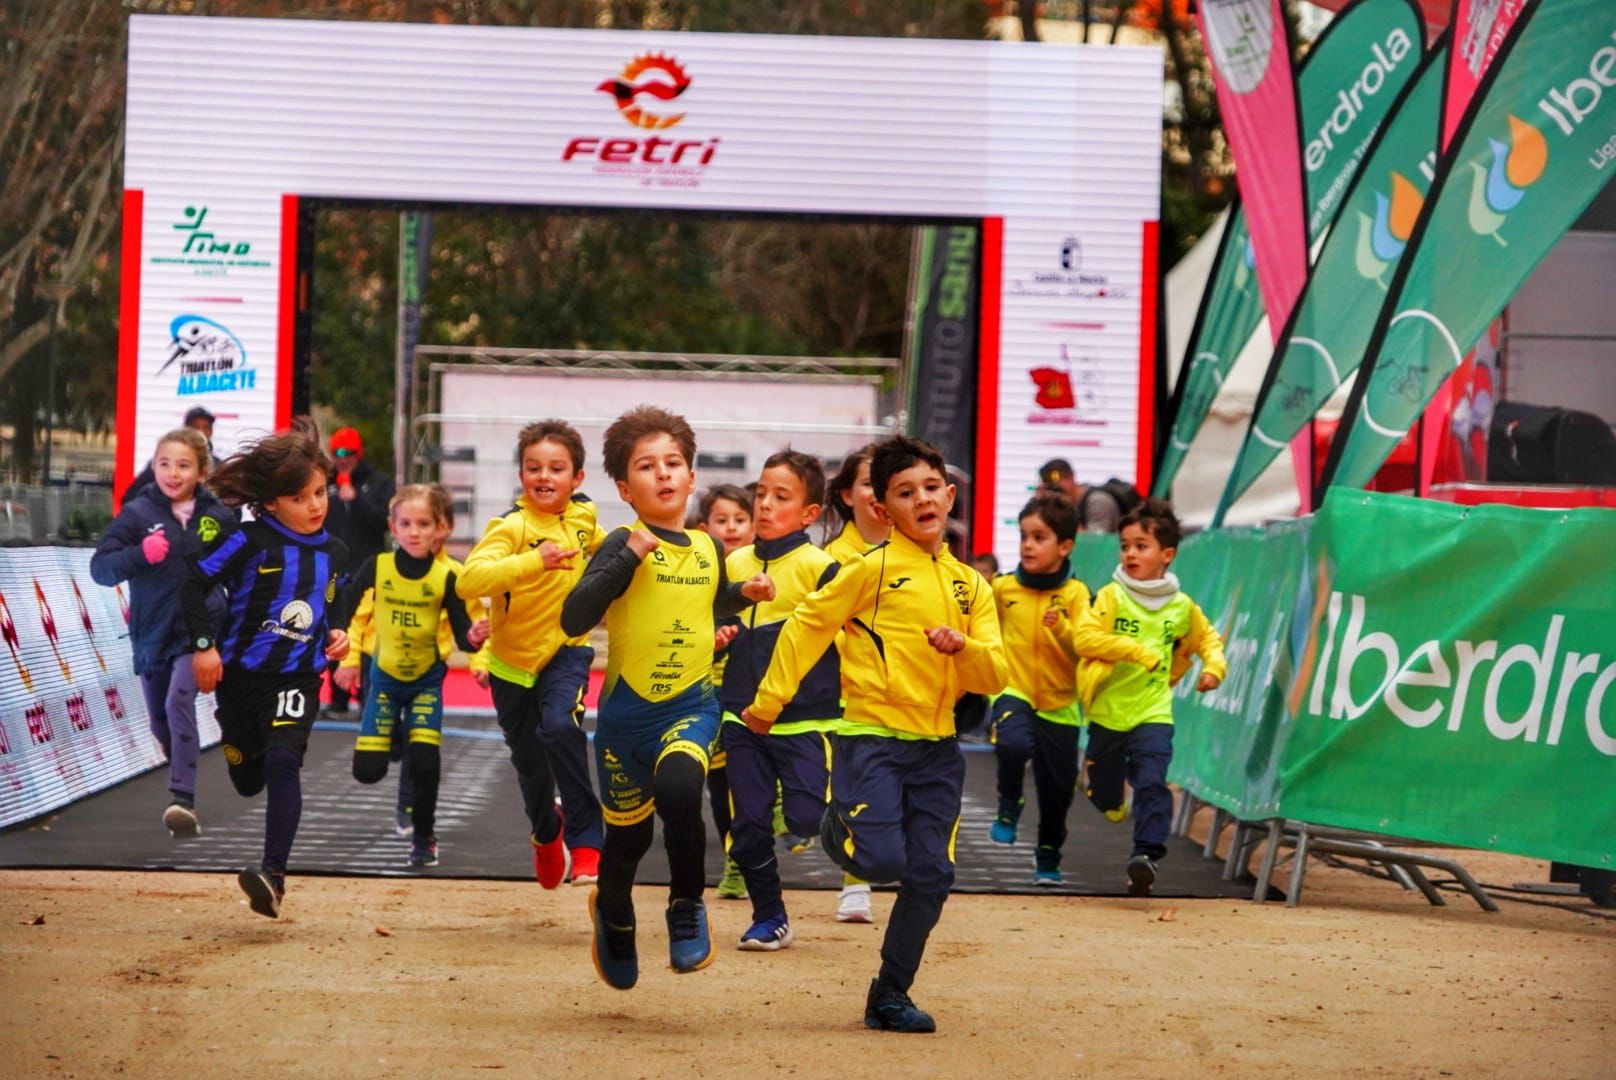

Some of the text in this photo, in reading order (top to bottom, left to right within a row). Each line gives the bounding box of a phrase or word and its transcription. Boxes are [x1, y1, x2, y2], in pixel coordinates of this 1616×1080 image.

[1538, 30, 1616, 136] Ibe
[392, 609, 422, 628] FIEL
[276, 688, 305, 718] 10
